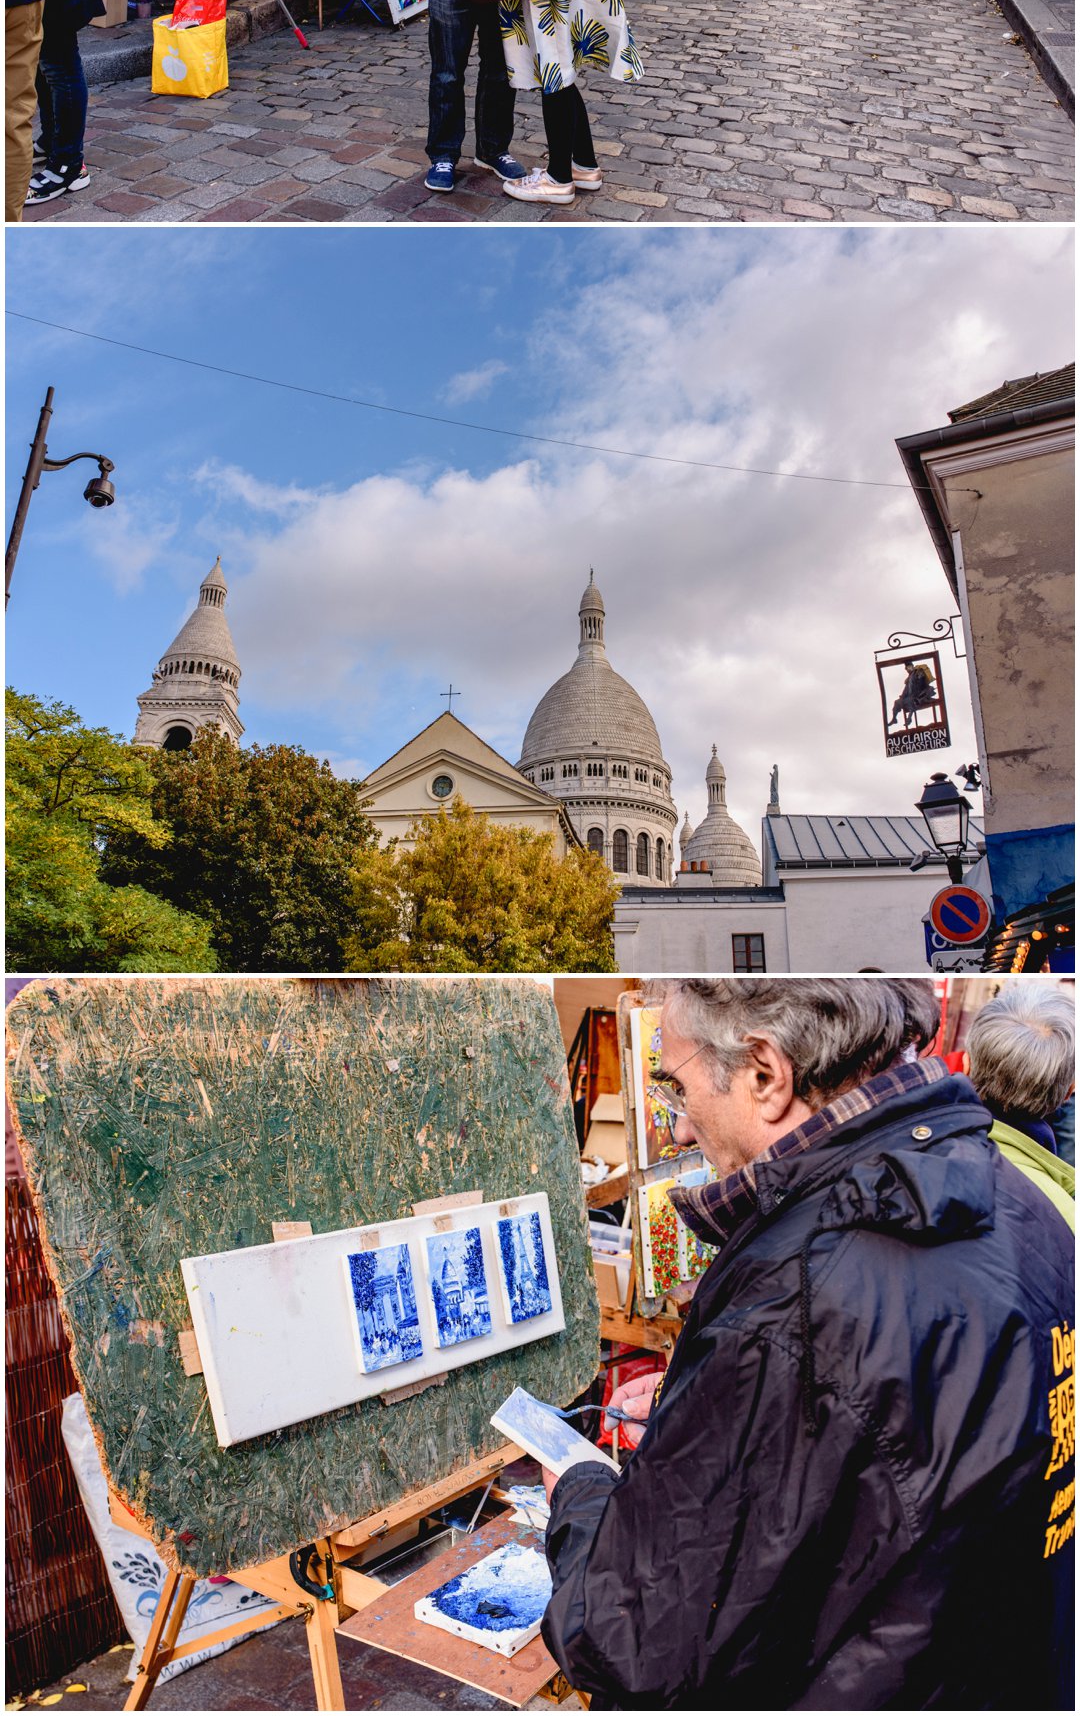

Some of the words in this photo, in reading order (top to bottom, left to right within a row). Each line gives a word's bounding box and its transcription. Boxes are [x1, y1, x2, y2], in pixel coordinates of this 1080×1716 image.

[886, 736, 900, 748] AU
[901, 728, 947, 745] CLAIRON
[900, 737, 948, 755] CHASSEURS
